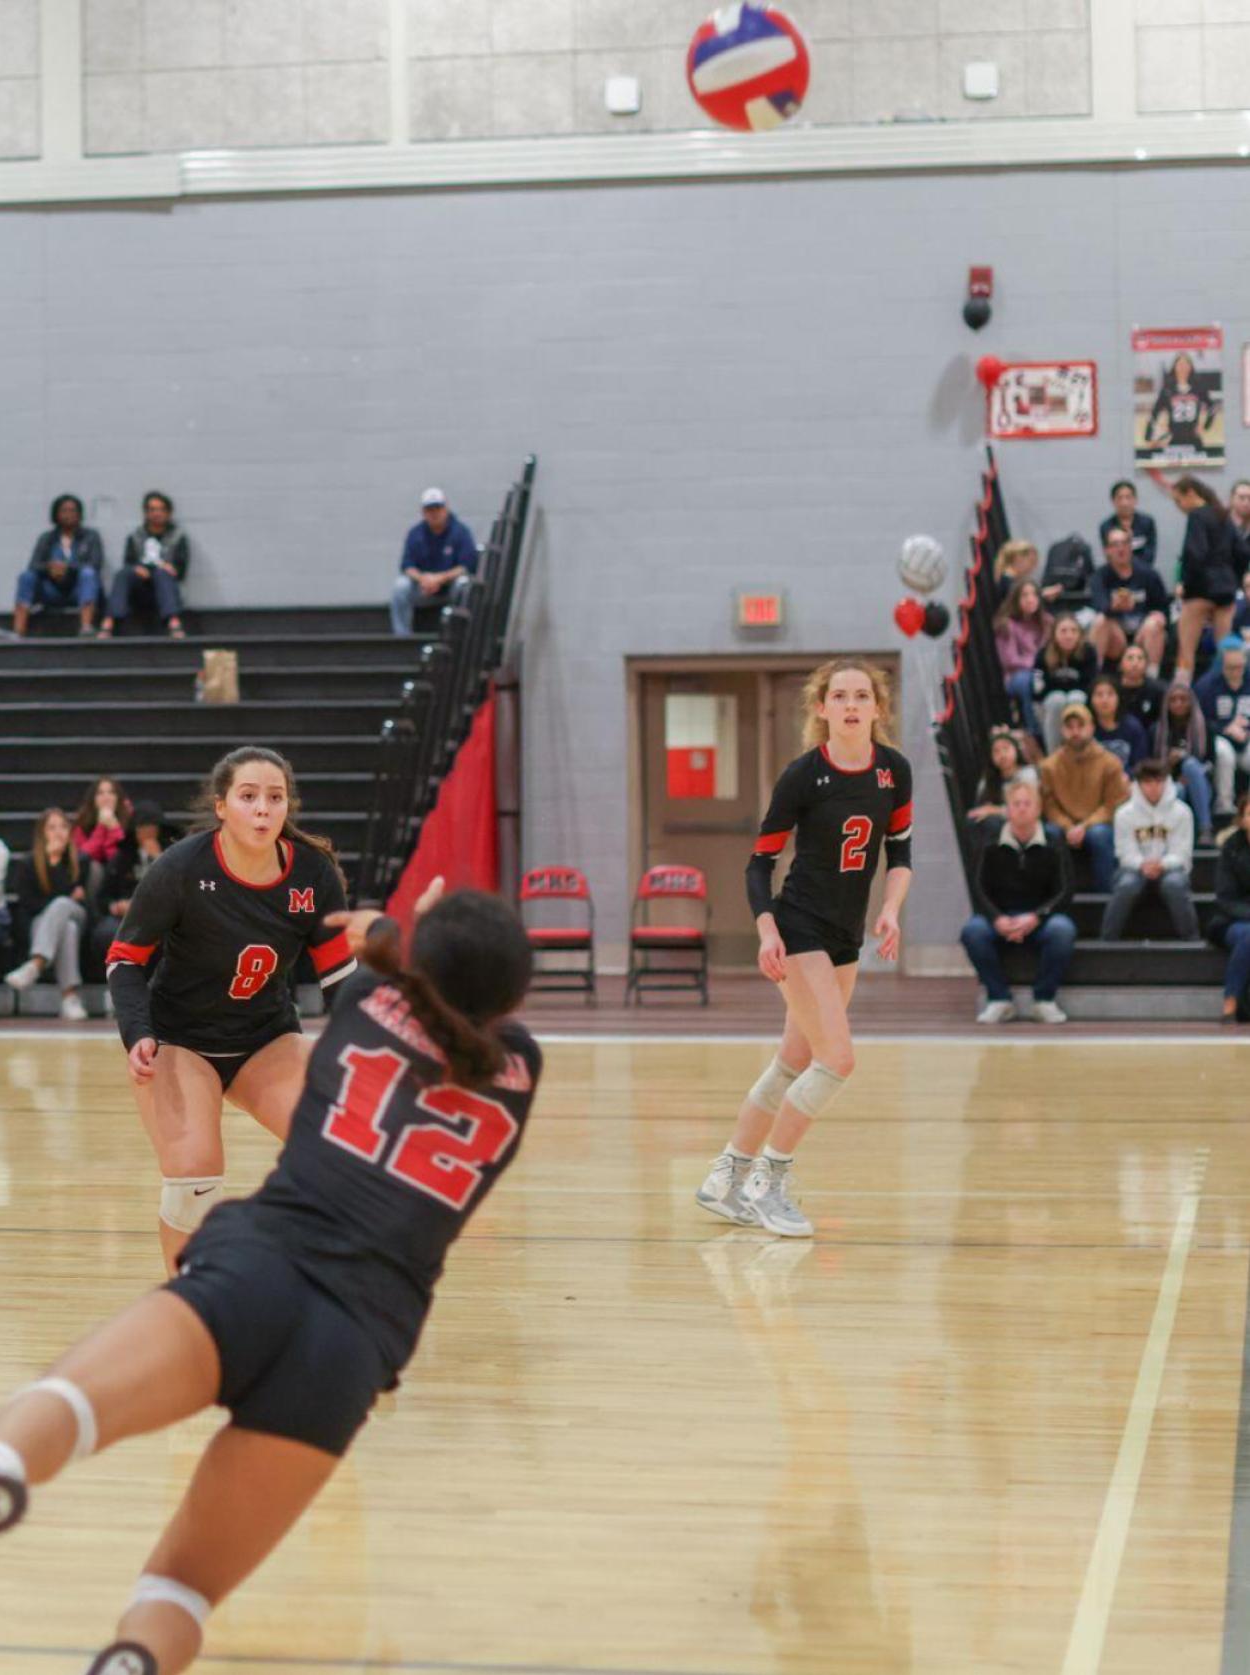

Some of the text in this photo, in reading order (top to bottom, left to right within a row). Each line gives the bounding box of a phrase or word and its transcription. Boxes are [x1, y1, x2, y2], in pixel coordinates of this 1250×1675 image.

[876, 768, 895, 788] M
[840, 815, 873, 872] 2
[288, 887, 315, 912] M
[228, 944, 278, 999] 8
[321, 1044, 519, 1211] 12
